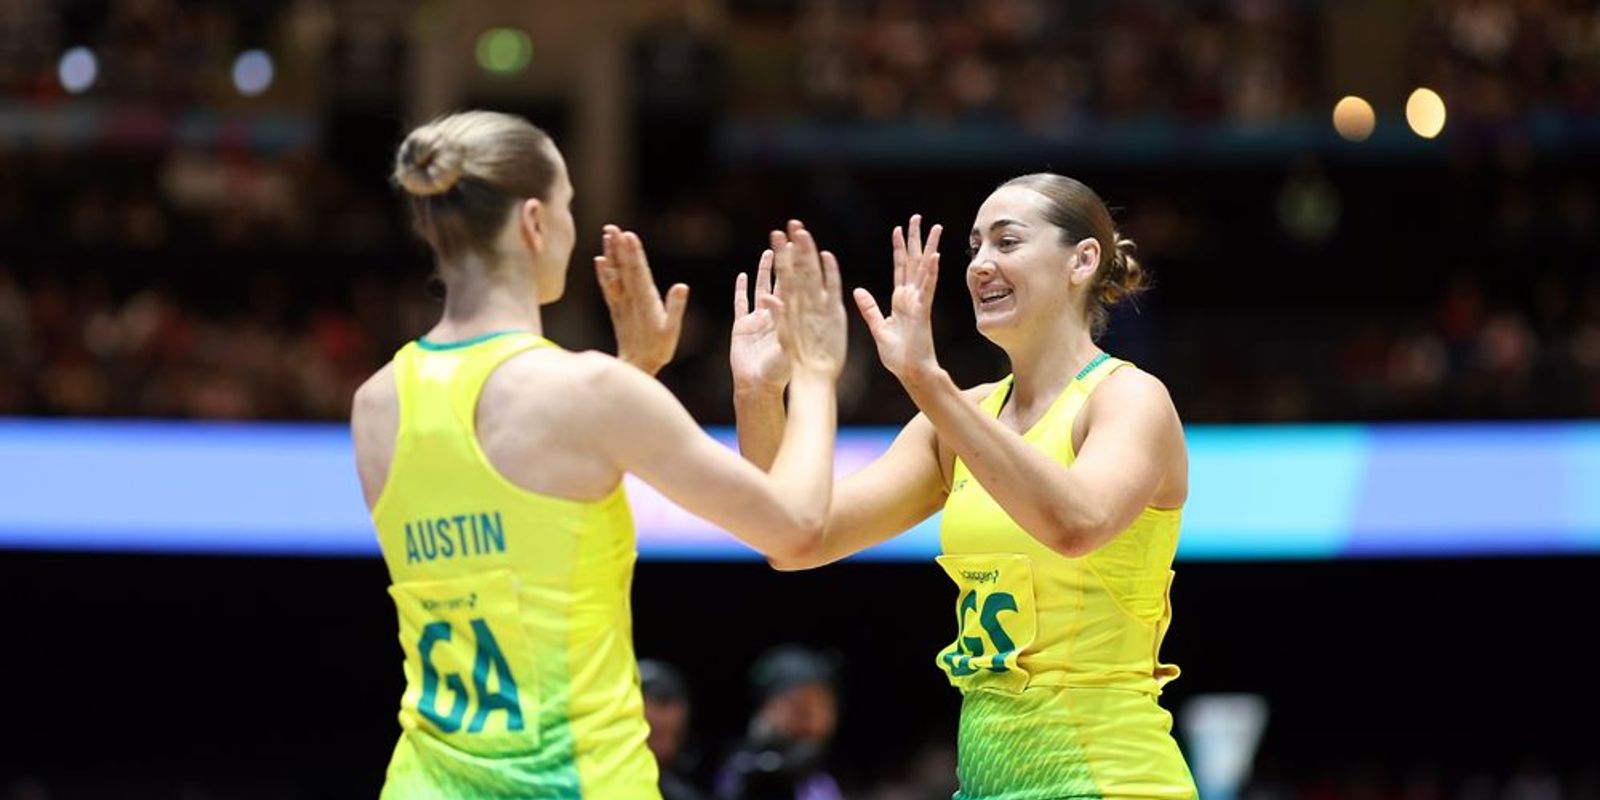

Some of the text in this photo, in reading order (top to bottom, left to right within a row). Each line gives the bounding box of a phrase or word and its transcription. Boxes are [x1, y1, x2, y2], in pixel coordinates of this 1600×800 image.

[404, 512, 506, 564] AUSTIN
[417, 618, 524, 733] GA
[943, 589, 1018, 676] GS
